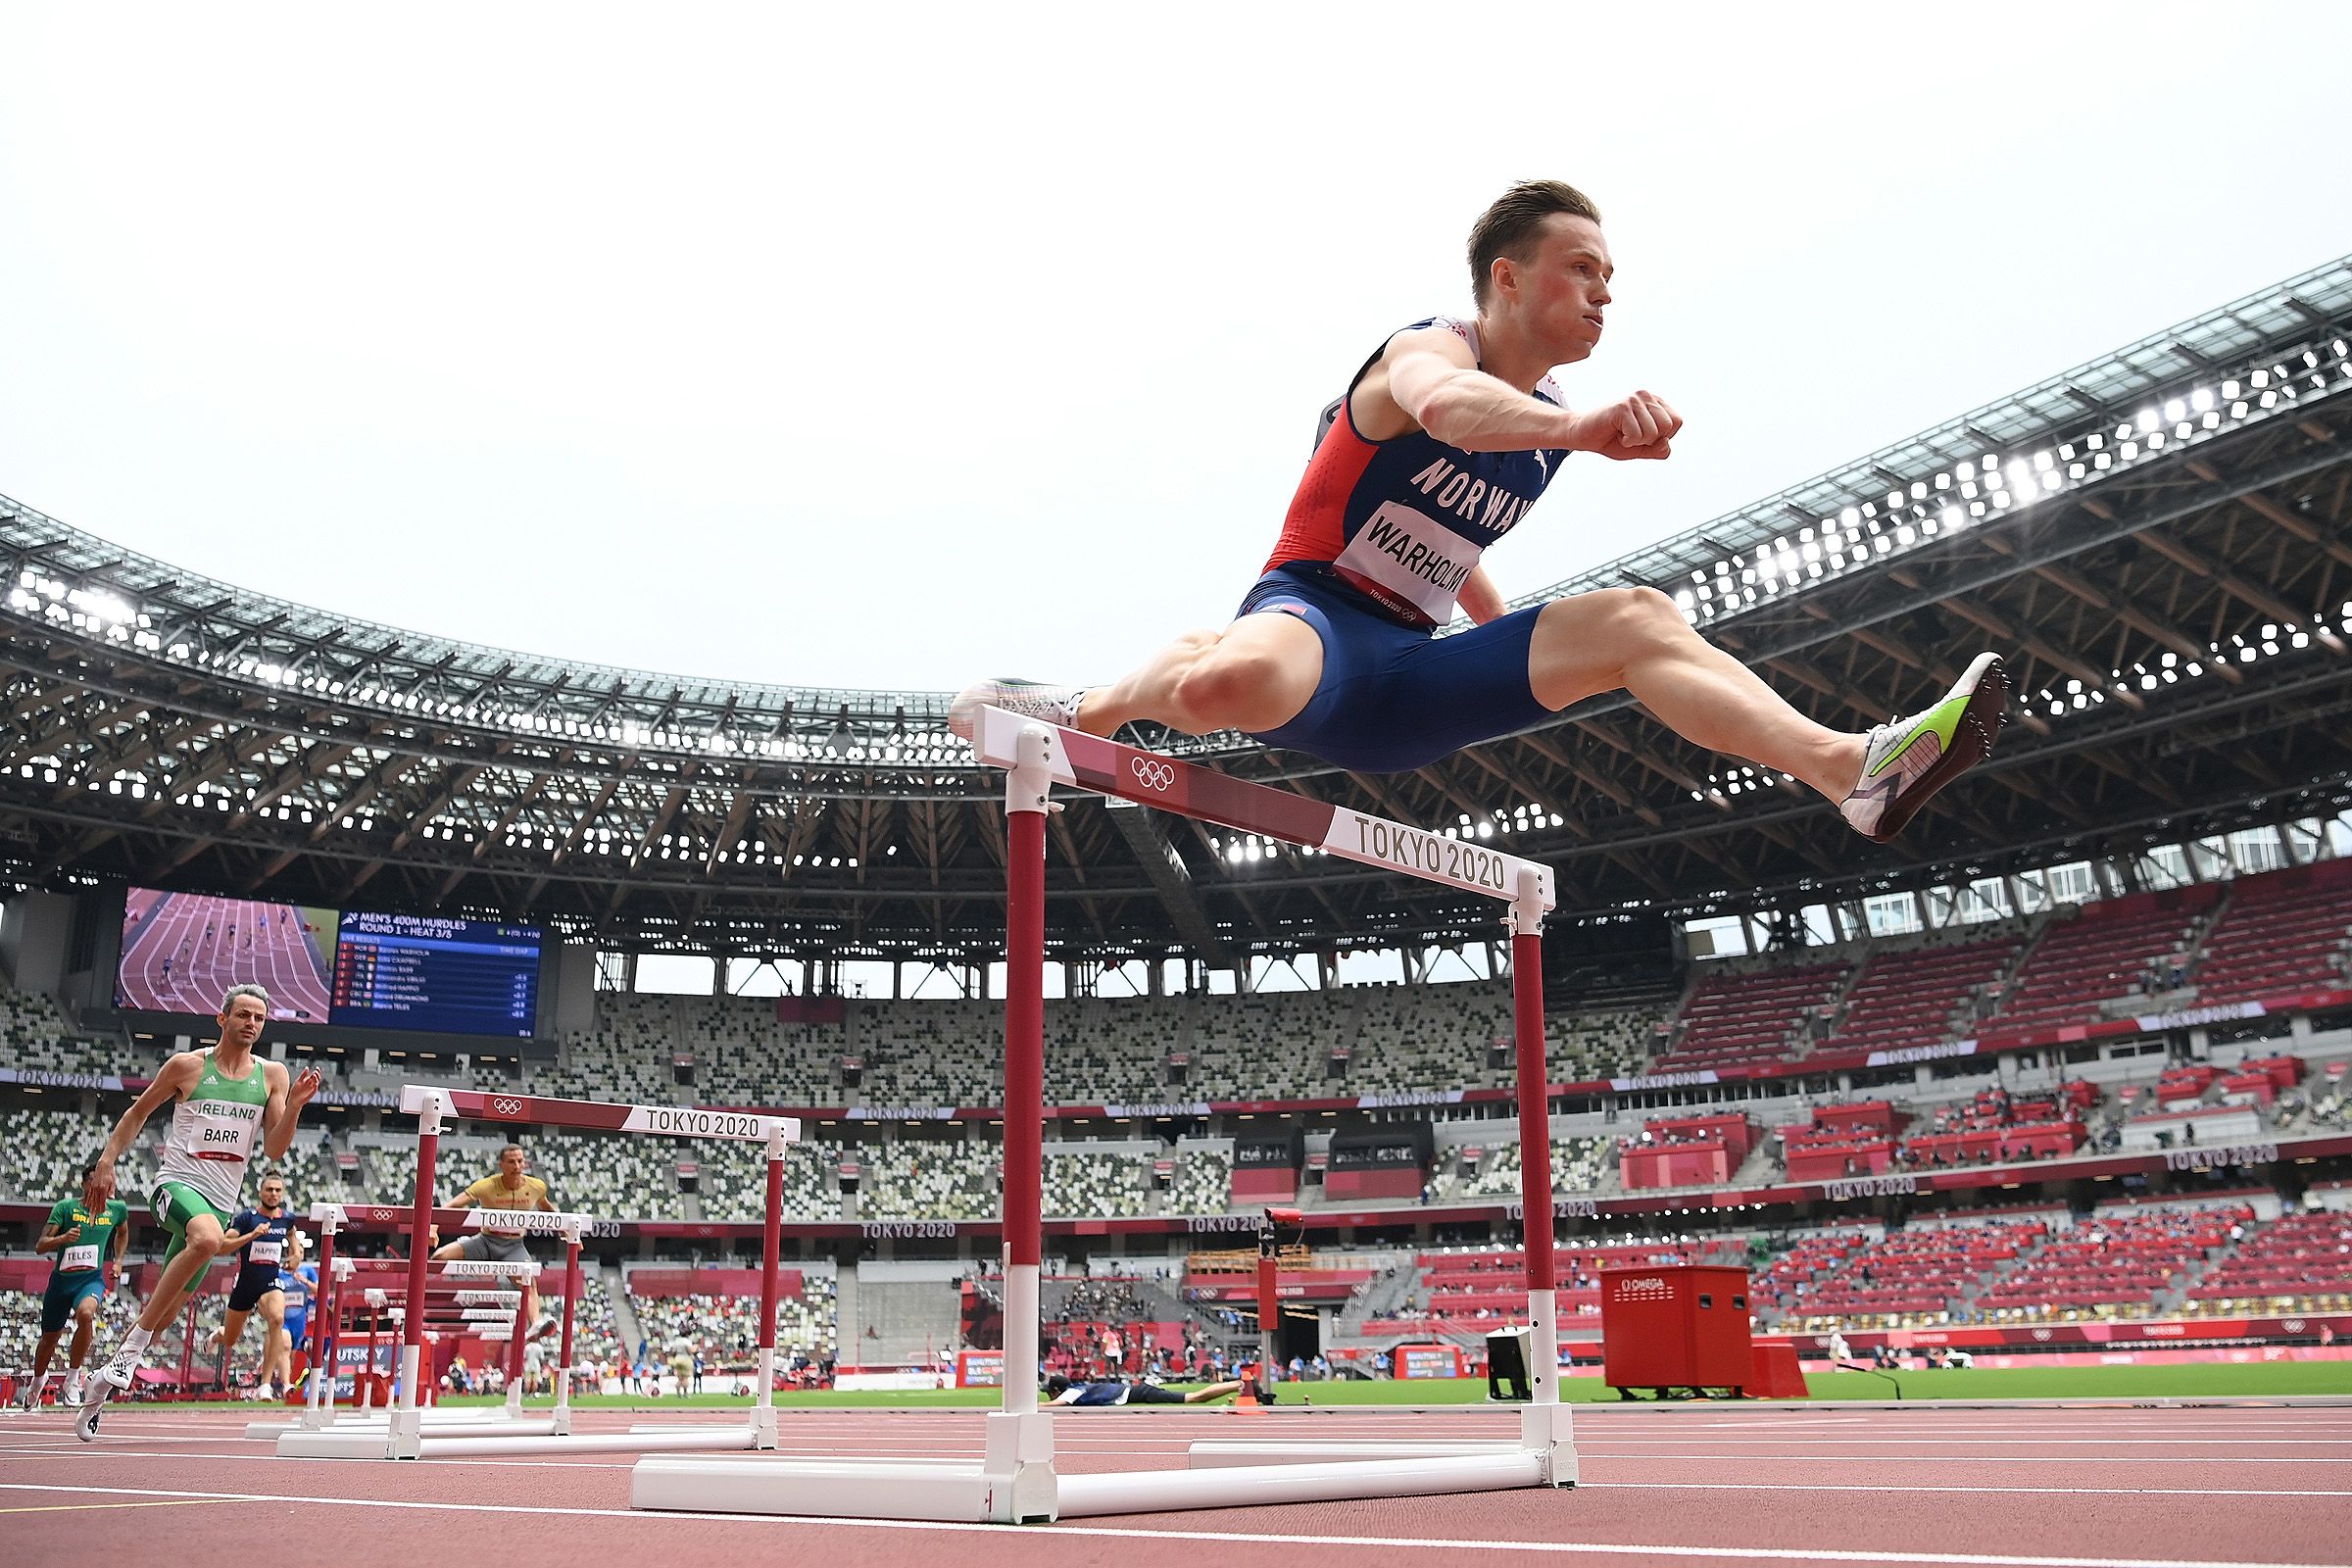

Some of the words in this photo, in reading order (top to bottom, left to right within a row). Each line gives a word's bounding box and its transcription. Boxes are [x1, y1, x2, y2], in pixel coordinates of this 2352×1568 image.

[1410, 457, 1535, 533] NORWAY
[1367, 514, 1469, 593] WARHOLM
[1370, 589, 1390, 606] TOKYO
[1388, 601, 1402, 612] 2020
[1354, 815, 1441, 873] TOKYO
[1446, 843, 1505, 890] 2020
[359, 921, 394, 934] ROUND
[396, 926, 401, 935] 1
[411, 927, 434, 938] HEAT
[360, 912, 391, 924] MEN'S
[393, 915, 420, 926] 400M
[422, 917, 467, 930] HURDLES
[16, 1070, 64, 1088] TOKYO
[68, 1074, 104, 1091] 2020
[1628, 1074, 1666, 1090] TOKYO
[1374, 1091, 1413, 1106] TOKYO
[198, 1102, 256, 1120] IRELAND
[864, 1106, 905, 1119] TOKYO
[907, 1106, 938, 1119] 2020
[1122, 1103, 1161, 1116] TOKYO
[647, 1109, 710, 1133] TOKYO
[714, 1115, 759, 1137] 2020
[203, 1128, 239, 1144] BARR
[2165, 1149, 2229, 1172] TOKYO
[2230, 1144, 2278, 1166] 2020
[1823, 1180, 1876, 1200] TOKYO
[1877, 1177, 1916, 1197] 2020
[1557, 1201, 1596, 1218] 2020
[481, 1213, 525, 1228] TOKYO
[529, 1216, 563, 1230] 2020
[580, 1222, 620, 1238] 020
[861, 1223, 914, 1238] TOKYO
[916, 1222, 956, 1238] 2020
[1186, 1216, 1238, 1233] TOKYO
[68, 1251, 92, 1261] TELES
[456, 1263, 490, 1274] TOKYO
[493, 1265, 518, 1274] 2020
[1632, 1278, 1665, 1290] OMEGA
[465, 1294, 491, 1303] TOKYO
[493, 1295, 514, 1303] 2020
